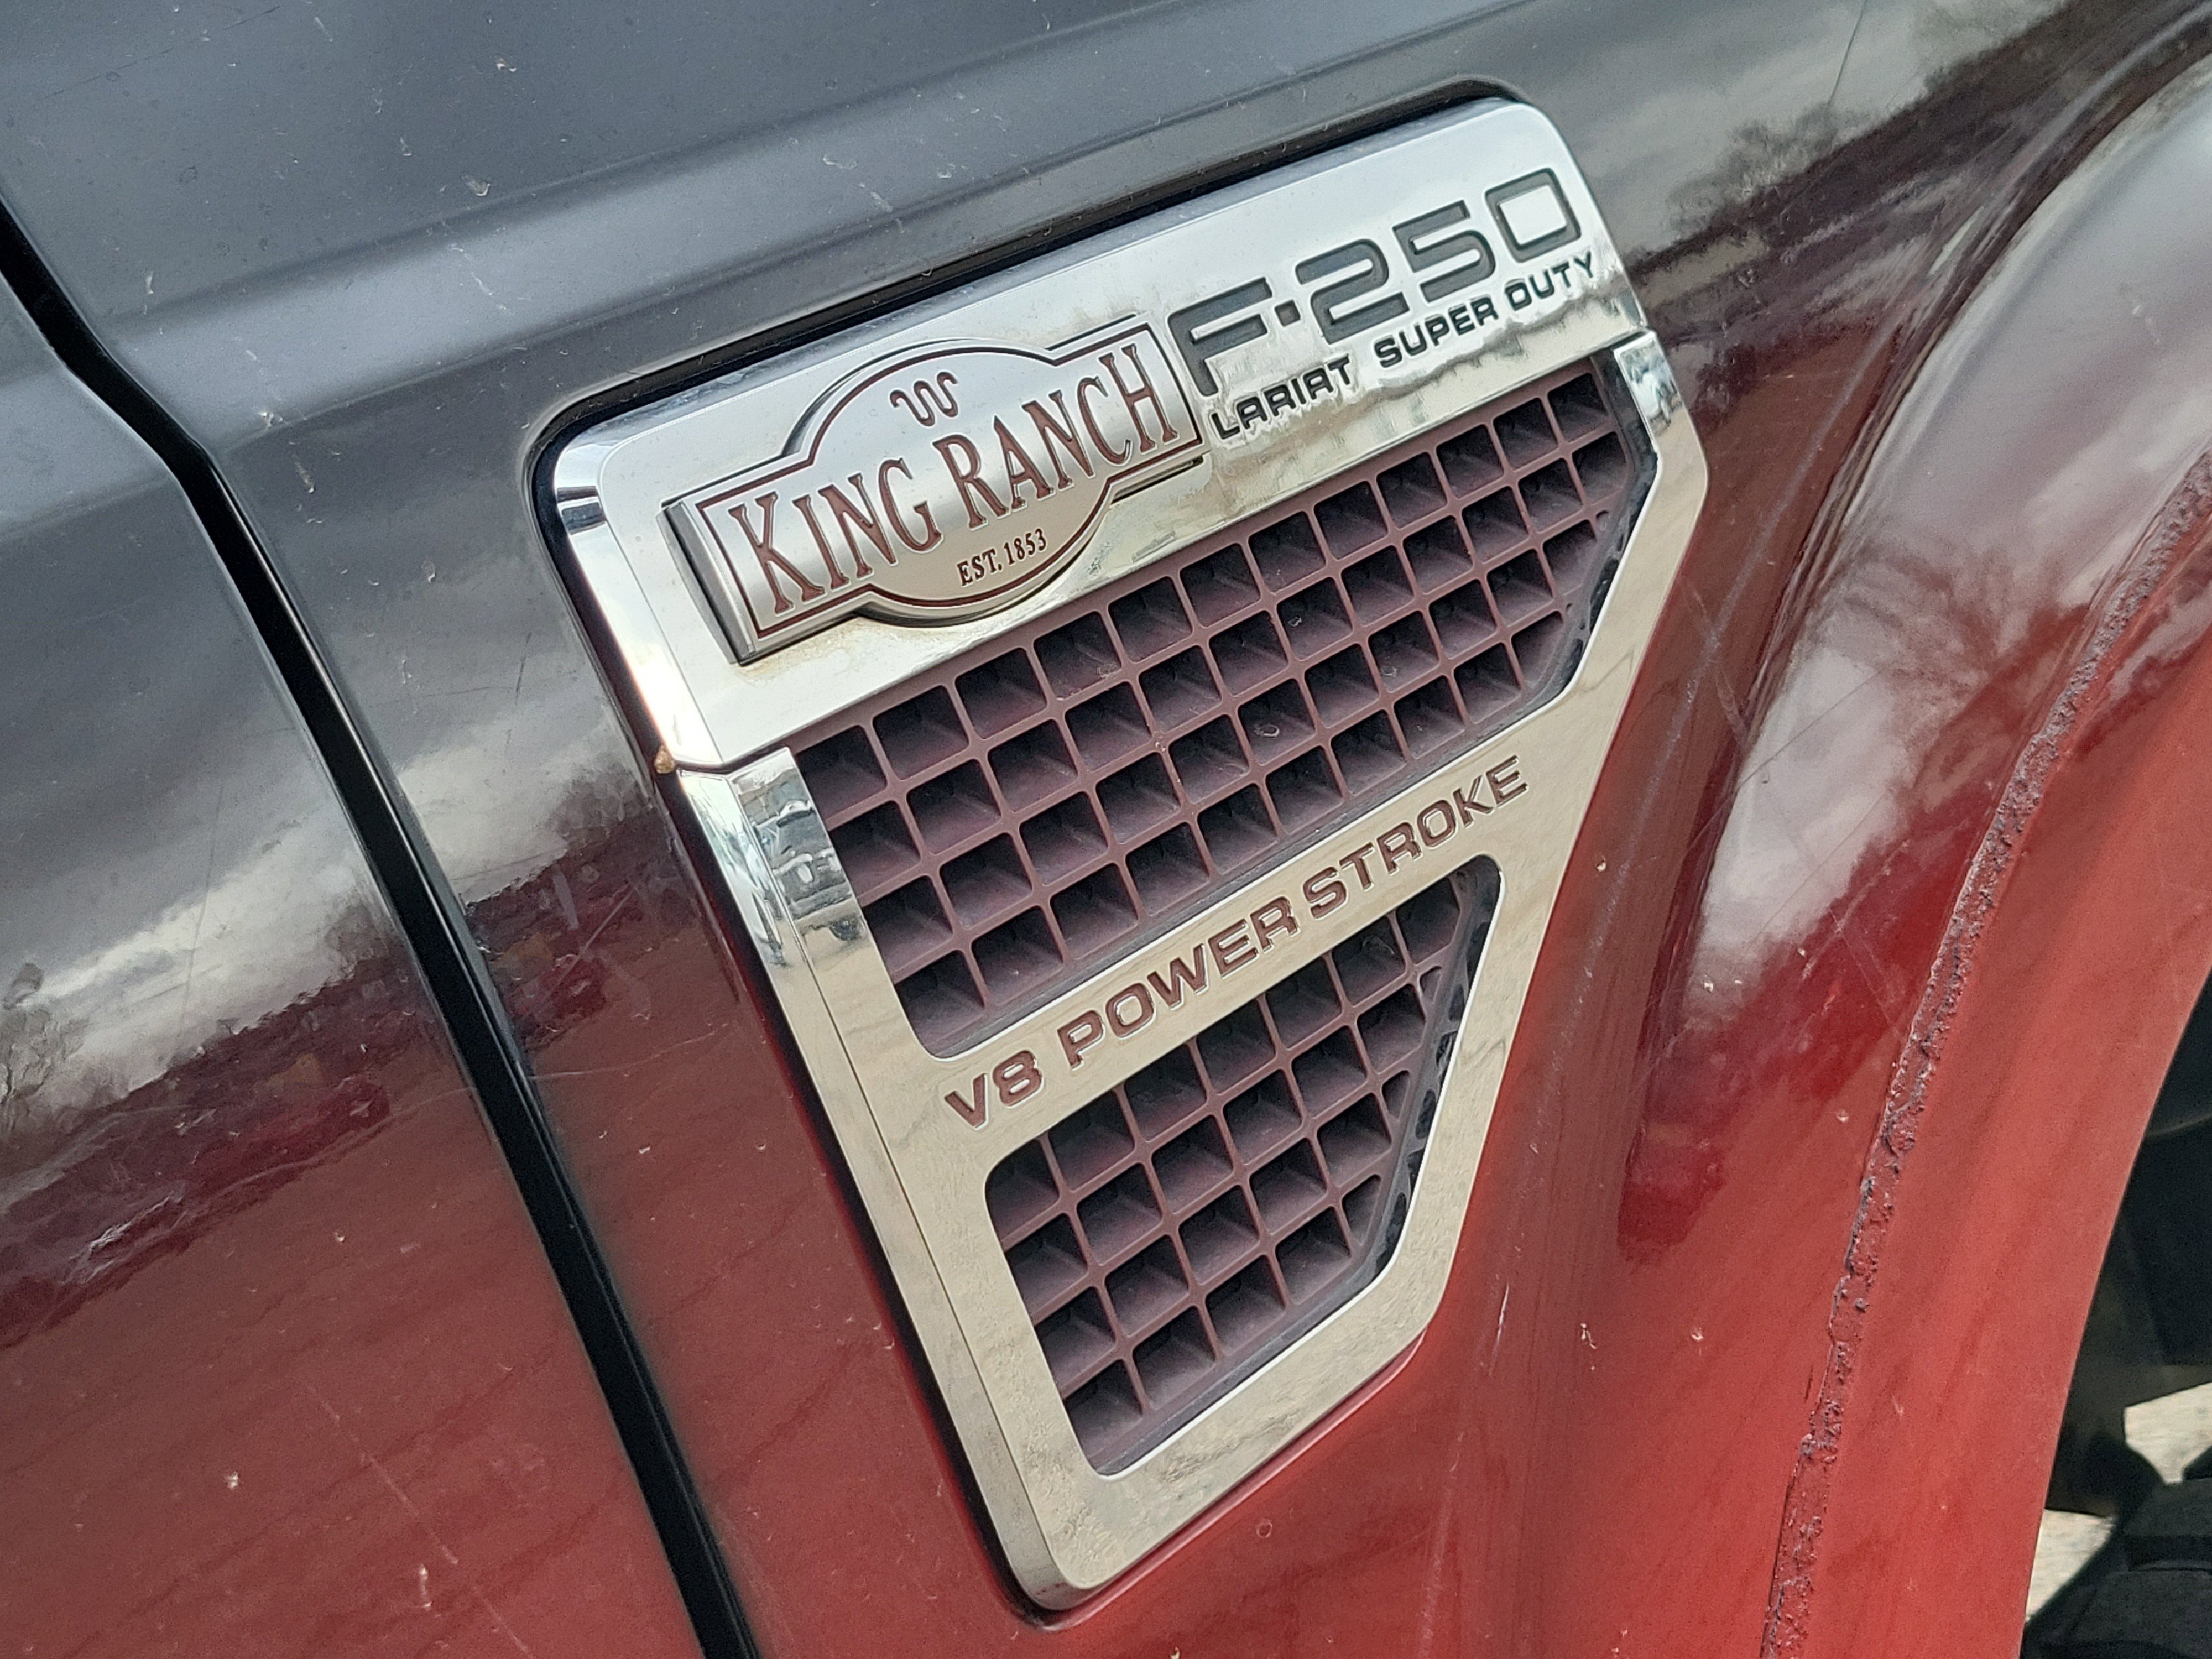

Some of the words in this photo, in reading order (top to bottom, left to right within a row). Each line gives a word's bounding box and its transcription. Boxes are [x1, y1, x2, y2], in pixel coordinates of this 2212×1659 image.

[1211, 353, 1350, 440] LARIAT
[1375, 297, 1498, 368] SUPER
[1506, 251, 1595, 311] DUTY
[728, 458, 943, 615] KING
[933, 344, 1178, 529] RANCH
[957, 549, 1004, 586] EST.
[1005, 528, 1047, 566] 1853
[945, 1050, 1042, 1129] V8
[1057, 896, 1299, 1069] POWER
[1302, 755, 1528, 920] STROKE
